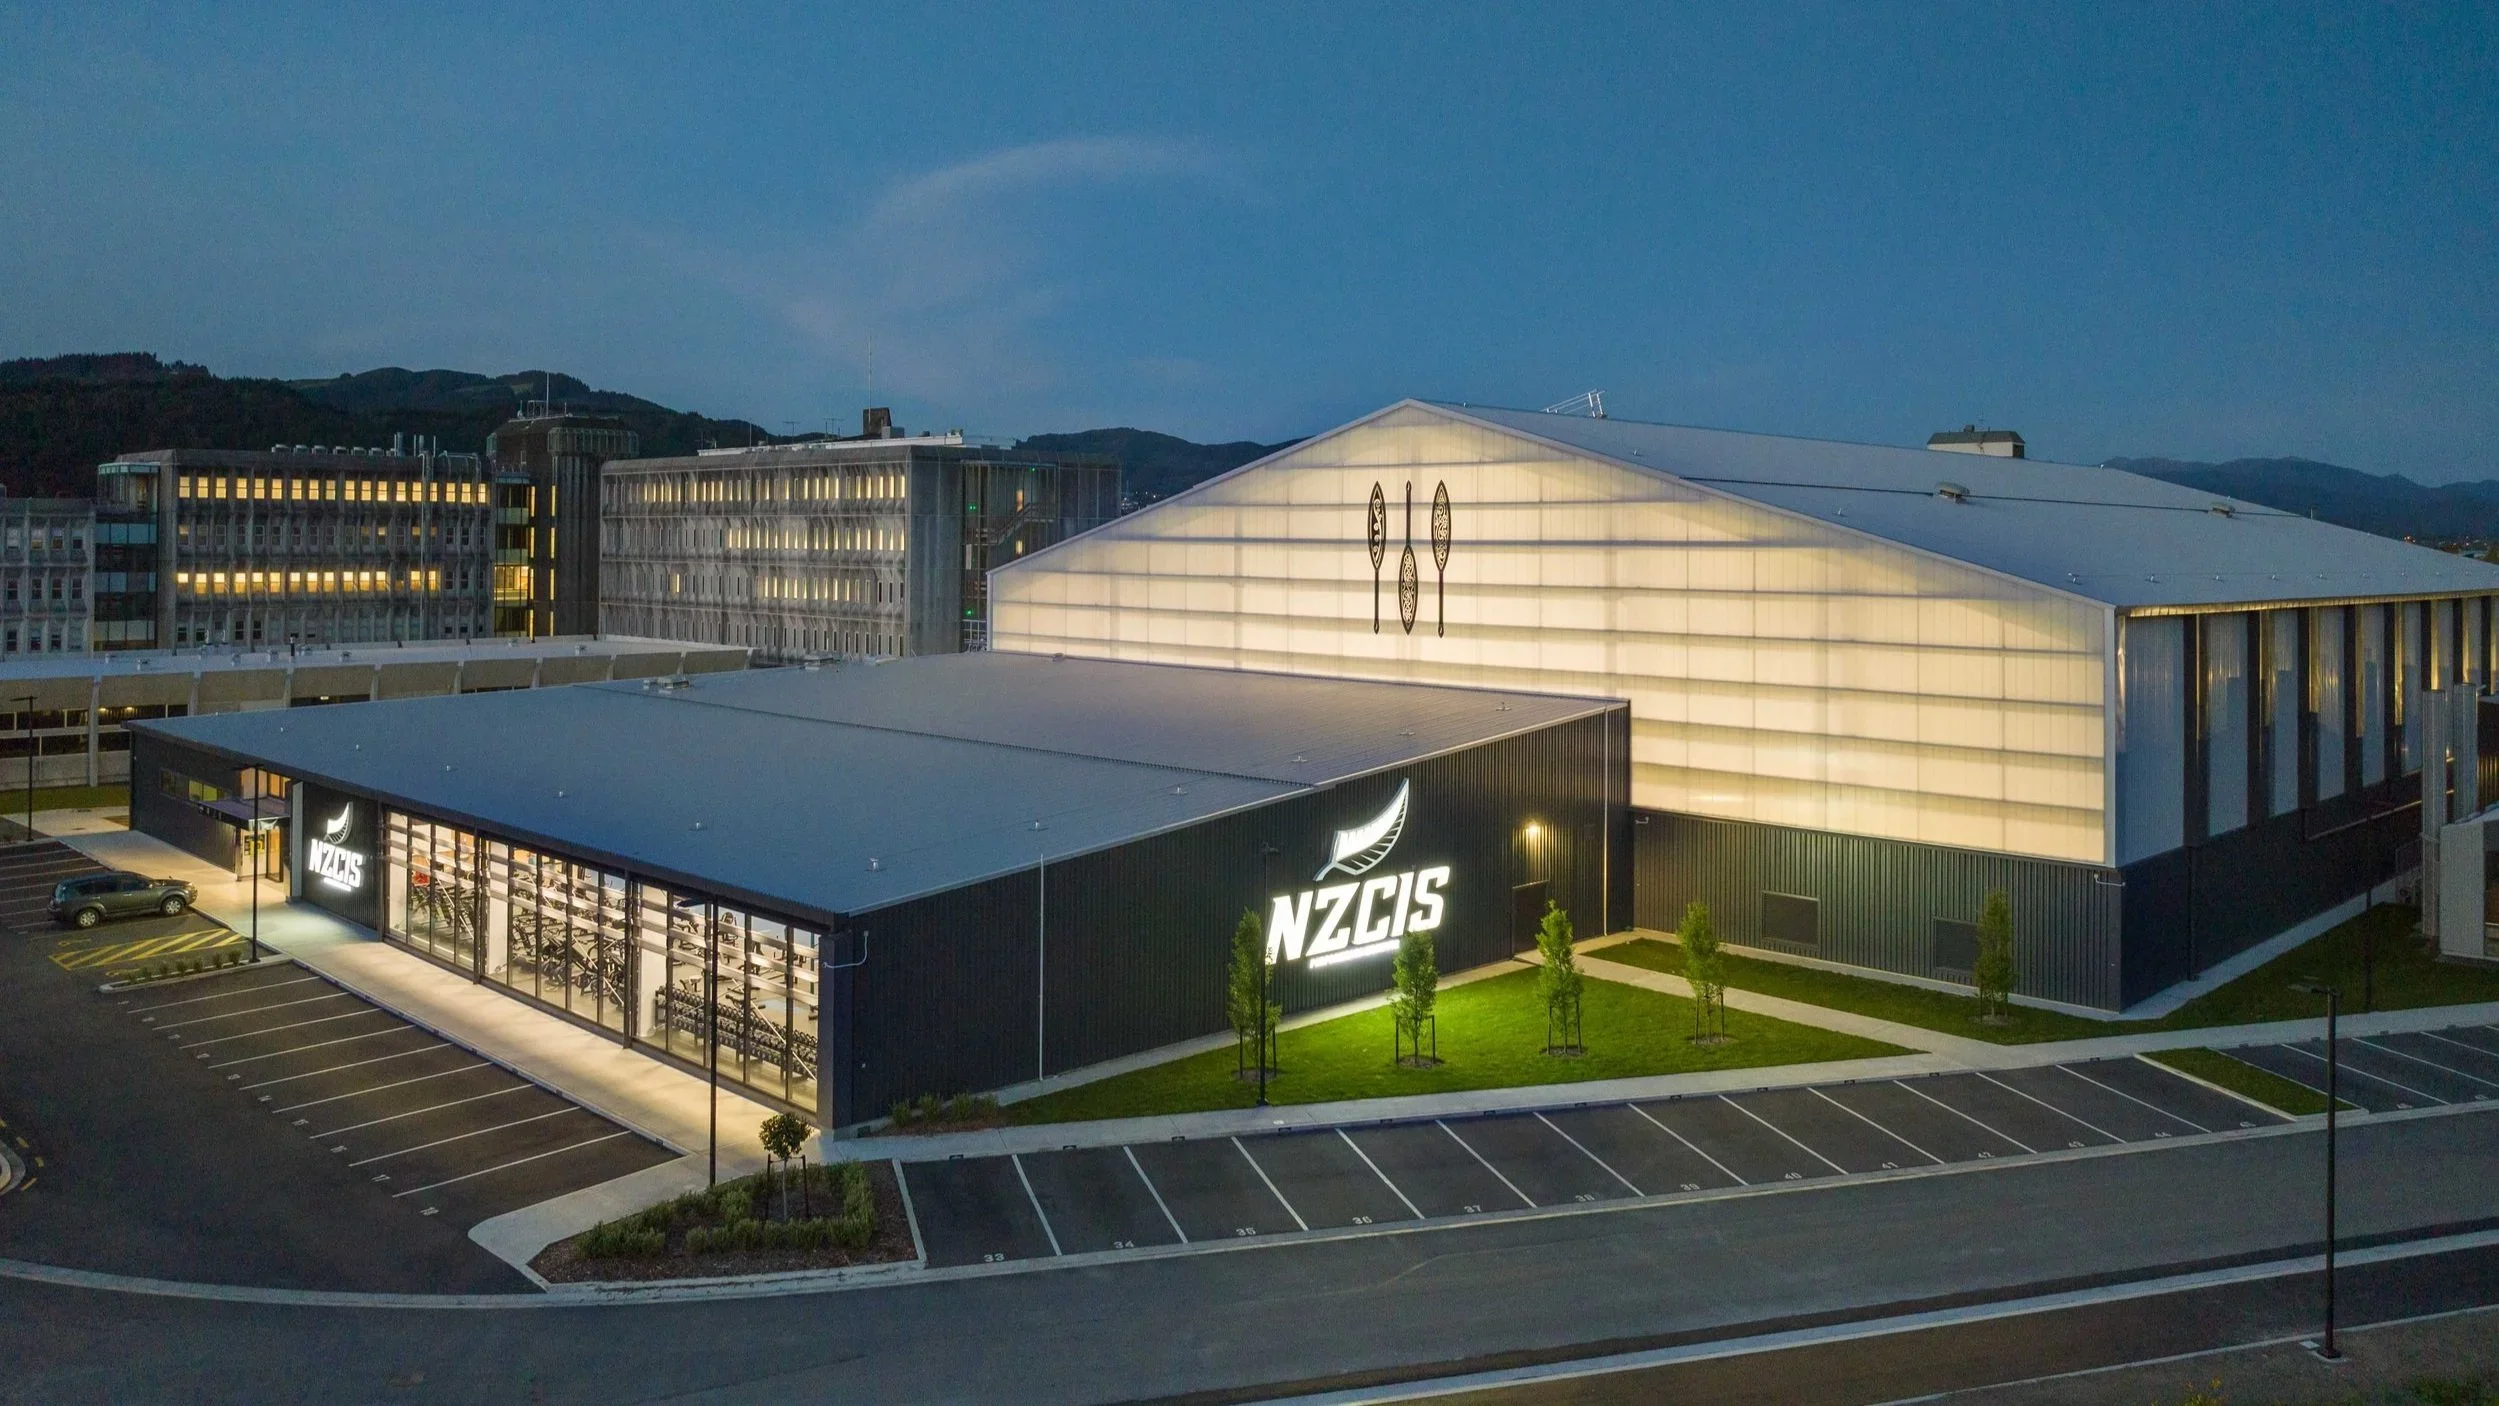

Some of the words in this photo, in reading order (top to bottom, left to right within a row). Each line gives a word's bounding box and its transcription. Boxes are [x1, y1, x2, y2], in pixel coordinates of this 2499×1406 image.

[309, 838, 364, 888] NZCIS
[1264, 866, 1450, 965] NZCIS
[1235, 1227, 1257, 1236] 35
[1113, 1240, 1135, 1249] 34
[983, 1253, 1005, 1263] 33
